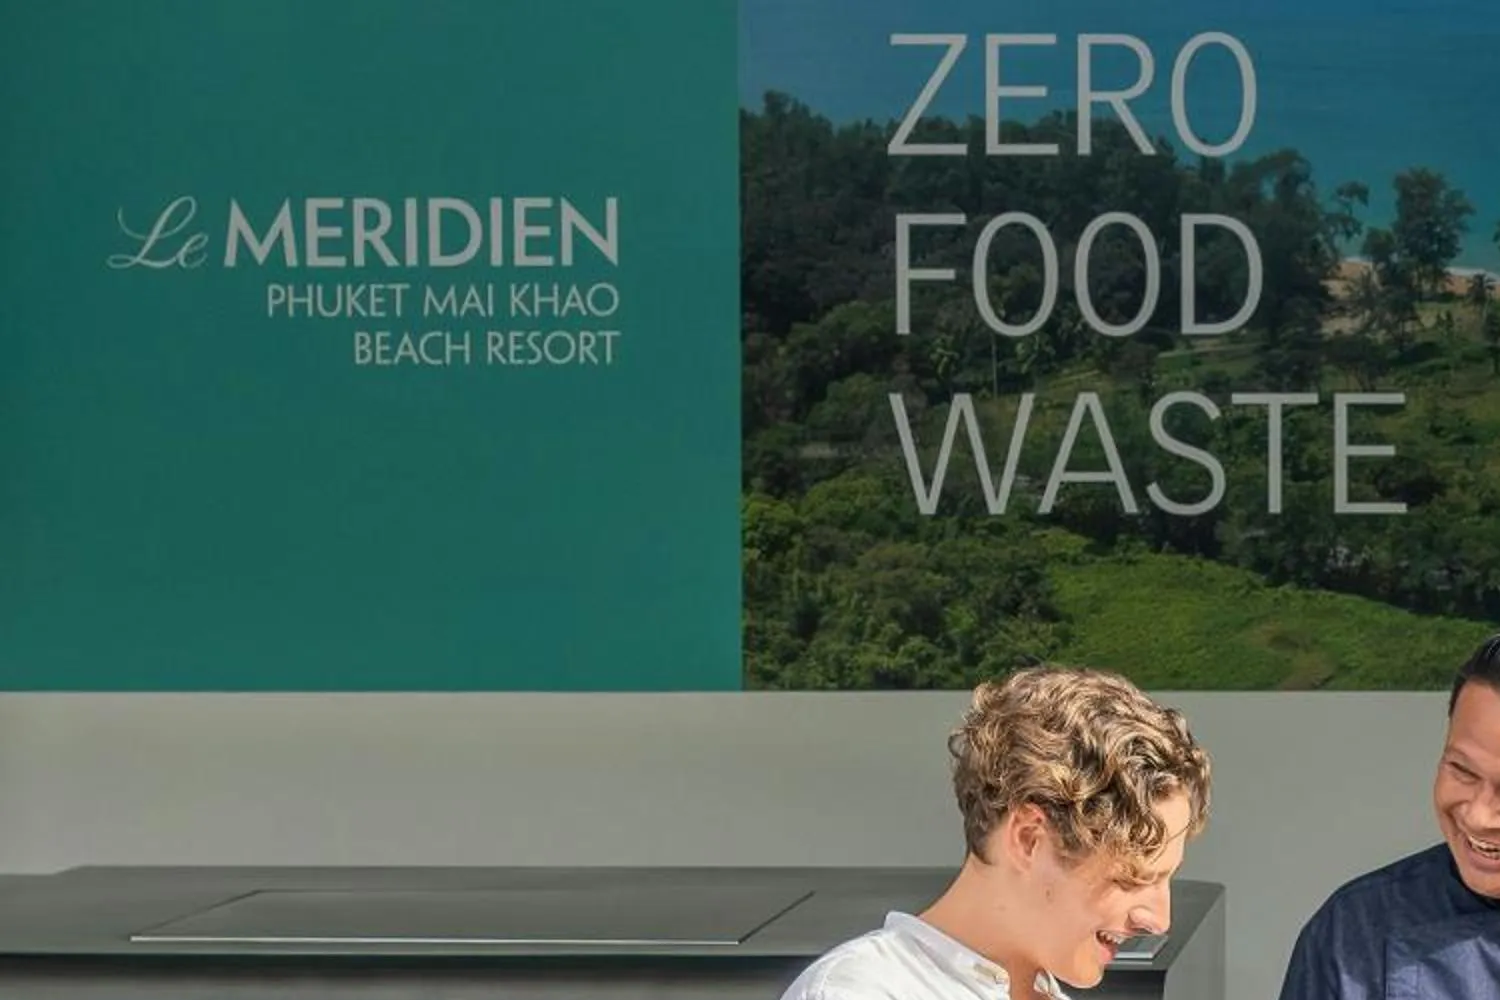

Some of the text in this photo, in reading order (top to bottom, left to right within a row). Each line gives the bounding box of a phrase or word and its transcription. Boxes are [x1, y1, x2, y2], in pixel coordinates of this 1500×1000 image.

[887, 31, 1257, 157] ZERO
[107, 196, 620, 269] Le MERIDIEN
[895, 211, 1263, 337] FOOD
[267, 283, 619, 317] PHUKET MAI KHAO
[354, 331, 620, 365] BEACH RESORT
[888, 391, 1408, 516] WASTE
